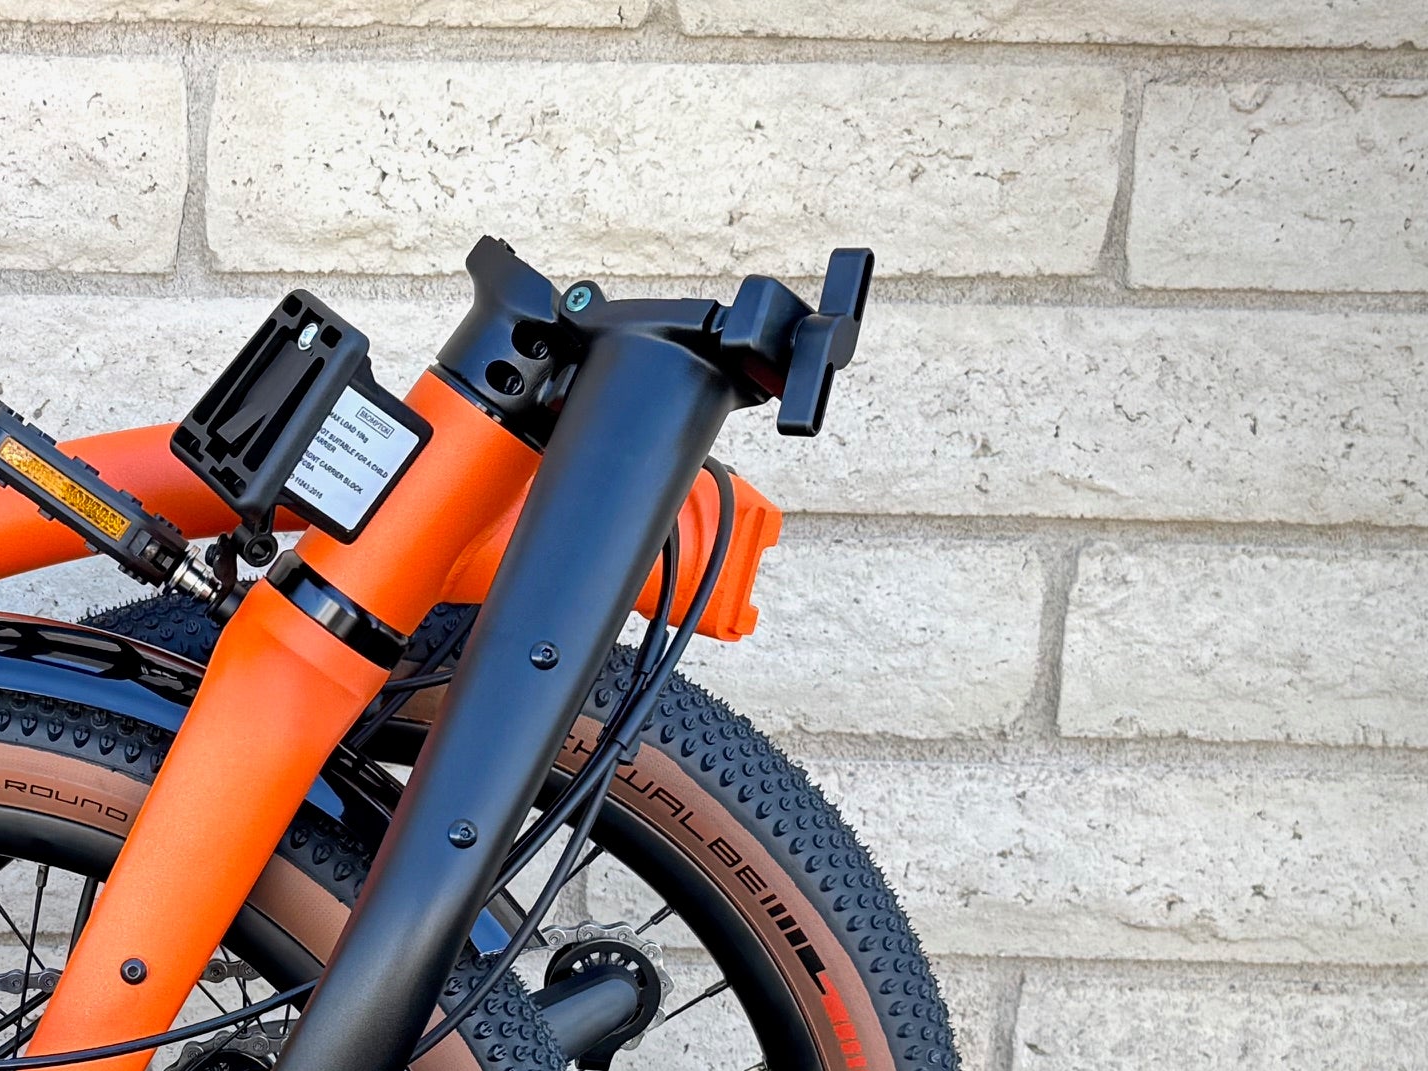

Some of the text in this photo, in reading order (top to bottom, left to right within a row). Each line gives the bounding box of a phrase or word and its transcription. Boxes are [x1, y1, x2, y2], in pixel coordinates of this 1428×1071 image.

[340, 419, 357, 433] LOAD
[356, 431, 368, 443] 10kg
[359, 410, 391, 435] BROMPTON
[315, 436, 337, 453] ARRIER
[329, 434, 355, 456] SUITABLE
[354, 453, 369, 464] FOR
[371, 464, 388, 479] CHILD
[319, 461, 344, 481] CARRIER
[343, 478, 363, 494] BLOCK
